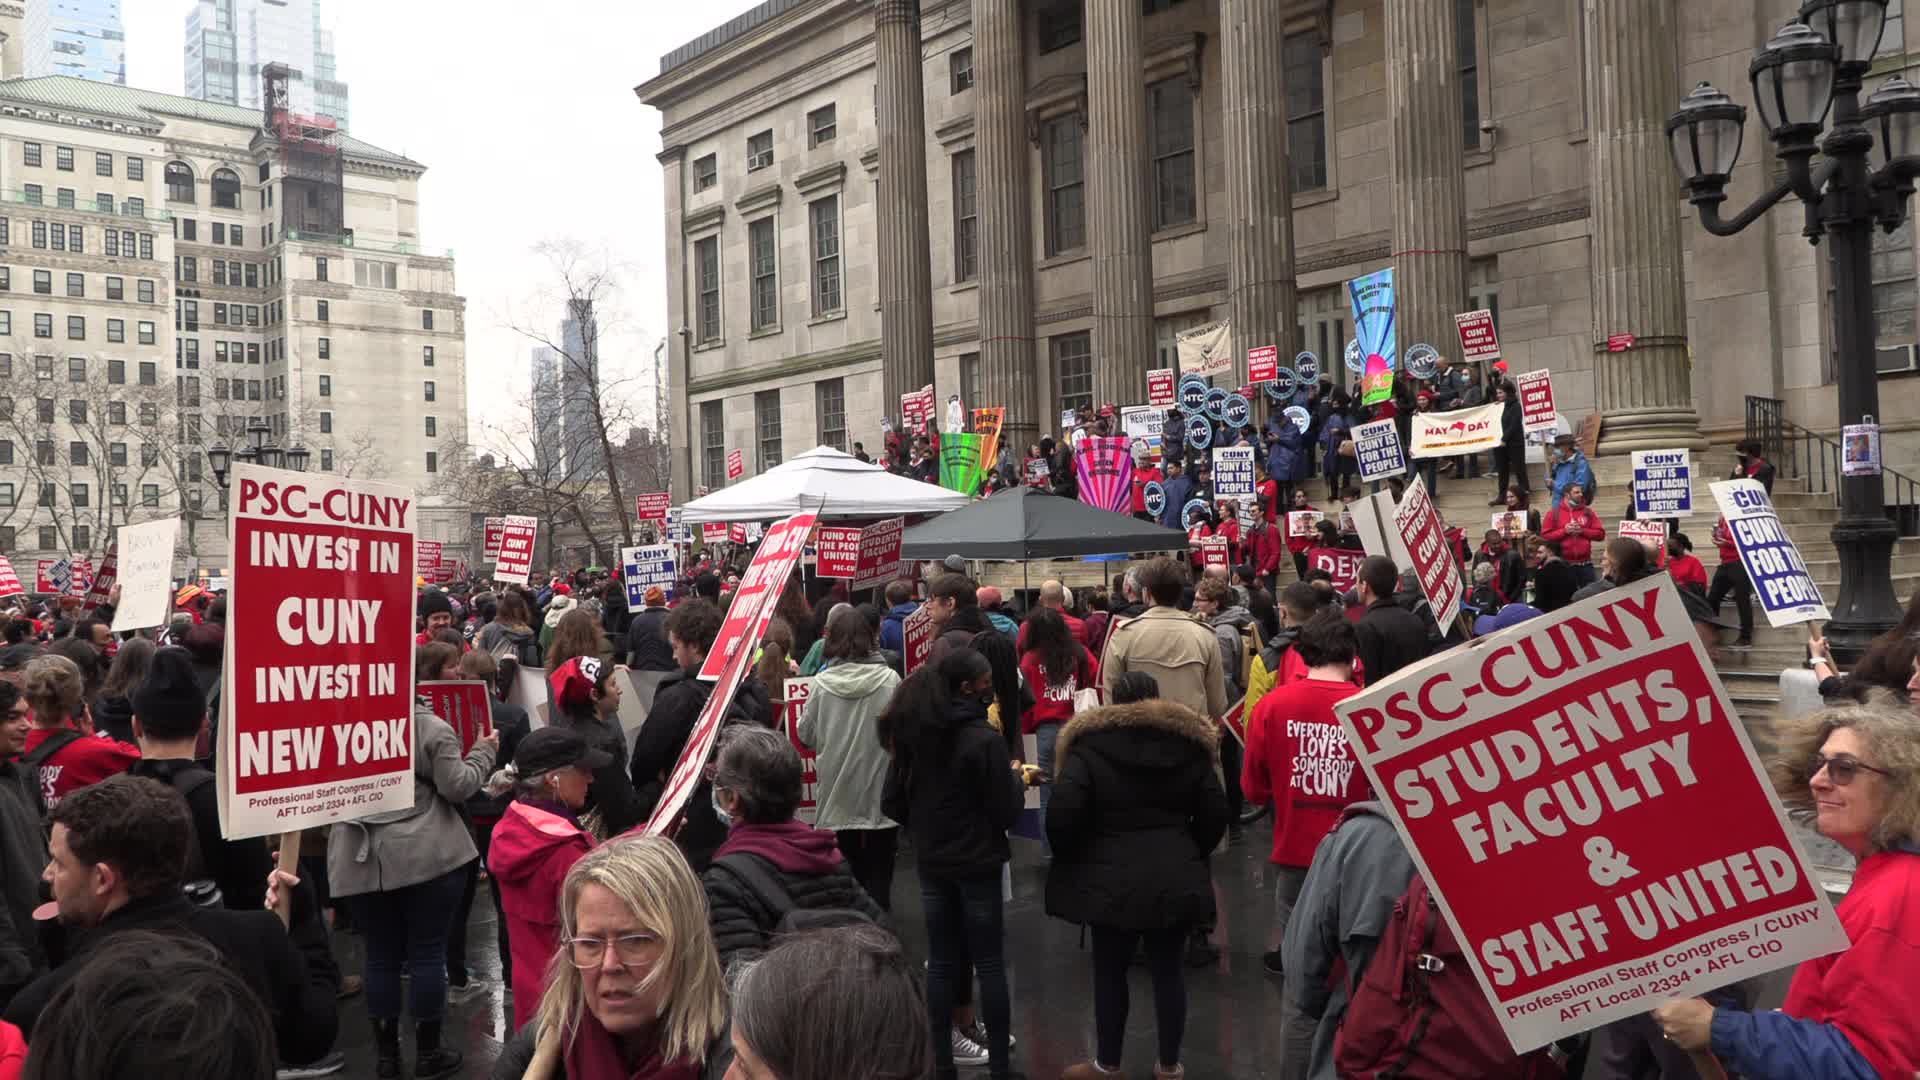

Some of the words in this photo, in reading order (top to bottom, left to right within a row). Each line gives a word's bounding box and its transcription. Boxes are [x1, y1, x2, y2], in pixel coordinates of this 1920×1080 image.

[1466, 327, 1487, 338] CUNY
[1299, 364, 1316, 372] HTC
[1411, 354, 1433, 369] HTC
[1152, 383, 1168, 391] CUNY
[1271, 379, 1292, 387] HTC
[1184, 394, 1204, 402] HTC
[1527, 391, 1546, 402] CUNY
[1227, 406, 1246, 417] HTC
[1147, 424, 1162, 433] RES
[1190, 428, 1207, 437] HTC
[1361, 424, 1391, 436] CUNY
[1425, 427, 1448, 436] MAY
[1468, 421, 1490, 432] DAY
[1358, 437, 1384, 452] CUNY
[1385, 434, 1396, 445] IS
[1360, 450, 1380, 463] FOR
[1380, 445, 1399, 458] THE
[1644, 454, 1683, 464] CUNY
[1217, 462, 1240, 471] CUNY
[1241, 461, 1251, 470] IS
[1365, 457, 1400, 474] PEOPLE
[1647, 469, 1667, 478] CUNY
[1668, 468, 1676, 477] IS
[1217, 473, 1235, 482] FOR
[1236, 472, 1252, 482] THE
[1636, 480, 1661, 490] ABOUT
[1662, 478, 1688, 488] RACIAL
[1219, 483, 1250, 493] PEOPLE
[1640, 492, 1646, 500] &
[1647, 489, 1686, 500] ECONOMIC
[239, 478, 410, 529] PSC-CUNY
[1146, 494, 1162, 502] HTC
[1395, 481, 1426, 530] PSC-CUNY
[1649, 500, 1679, 511] JUSTICE
[822, 531, 845, 541] FUND
[1404, 512, 1429, 546] INVEST
[1735, 518, 1783, 546] CUNY
[506, 538, 528, 549] CUNY
[819, 542, 836, 550] THE
[863, 541, 898, 558] FACULTY
[1418, 524, 1440, 565] CUNY
[250, 530, 361, 572] INVEST
[370, 541, 399, 574] IN
[634, 549, 670, 560] CUNY
[1208, 554, 1223, 562] CUNY
[511, 562, 529, 573] YORK
[637, 562, 655, 574] CUNY
[656, 562, 664, 572] IS
[1747, 547, 1788, 577] FOR
[627, 573, 651, 585] ABOUT
[651, 571, 675, 583] RACIAL
[1424, 558, 1446, 590] INVEST
[631, 587, 638, 595] &
[1432, 584, 1449, 617] NEW
[276, 596, 383, 646] CUNY
[1347, 587, 1672, 754] PSC-CUNY
[256, 664, 360, 703] INVEST
[369, 663, 395, 696] IN
[240, 726, 325, 778] NEW
[332, 718, 408, 766] YORK
[1299, 735, 1348, 759] LOVES
[1393, 669, 1713, 820] STUDENTS,
[1292, 757, 1356, 773] SOMEBODY
[1290, 775, 1302, 787] AT
[1302, 769, 1353, 798] CUNY
[249, 791, 314, 808] Professional
[316, 786, 336, 799] Staff
[338, 781, 374, 796] Congress
[381, 775, 402, 788] CUNY
[1452, 730, 1699, 865] FACULTY
[276, 805, 298, 818] AFT
[301, 802, 324, 815] Local
[326, 799, 346, 810] 2334
[352, 794, 366, 805] AFL
[368, 791, 383, 802] CIO
[1582, 836, 1639, 886] &
[1481, 903, 1609, 986] STAFF
[1615, 845, 1799, 941] UNITED
[1506, 972, 1614, 1020] Professional
[1618, 959, 1660, 982] Staff
[1662, 928, 1750, 971] Congress
[1764, 907, 1820, 933] CUNY
[1558, 1001, 1593, 1023] AFT
[1597, 986, 1648, 1011] Local
[1650, 969, 1692, 994] 2334
[1707, 952, 1745, 974] AFL
[1747, 938, 1784, 959] CIO
